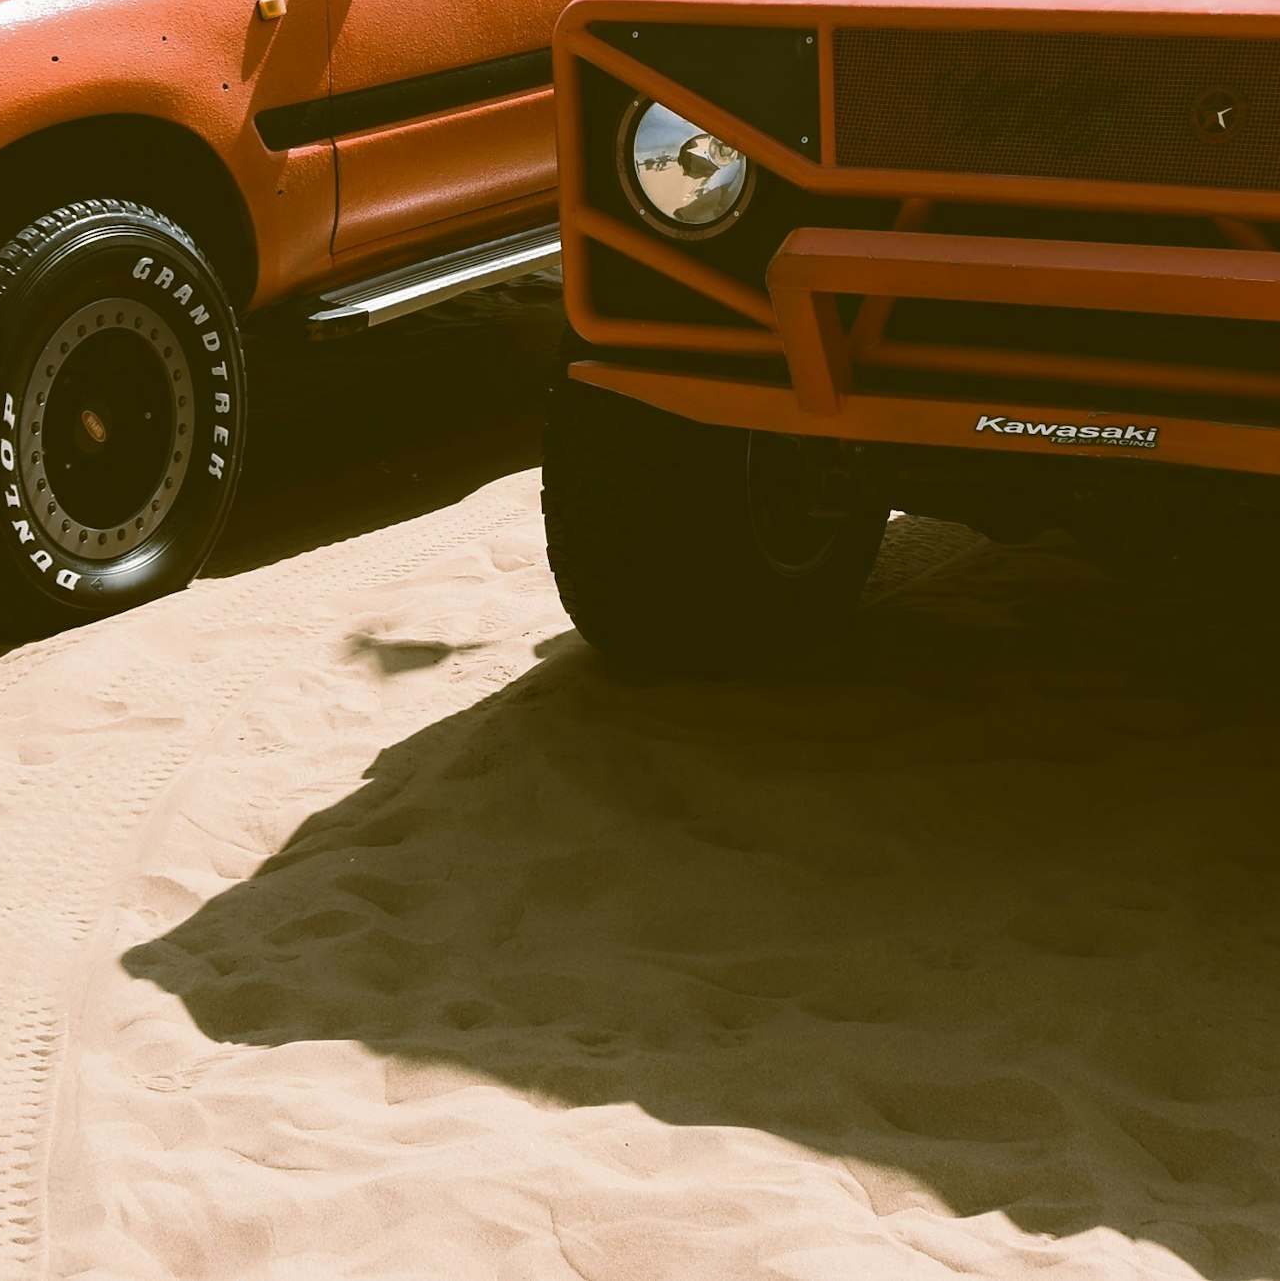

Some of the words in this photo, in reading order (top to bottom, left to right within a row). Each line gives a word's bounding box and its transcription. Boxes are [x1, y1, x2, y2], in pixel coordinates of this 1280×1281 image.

[132, 257, 230, 480] GRANDTREK
[975, 415, 1158, 442] Kawasaki
[0, 393, 81, 591] DUNLOP
